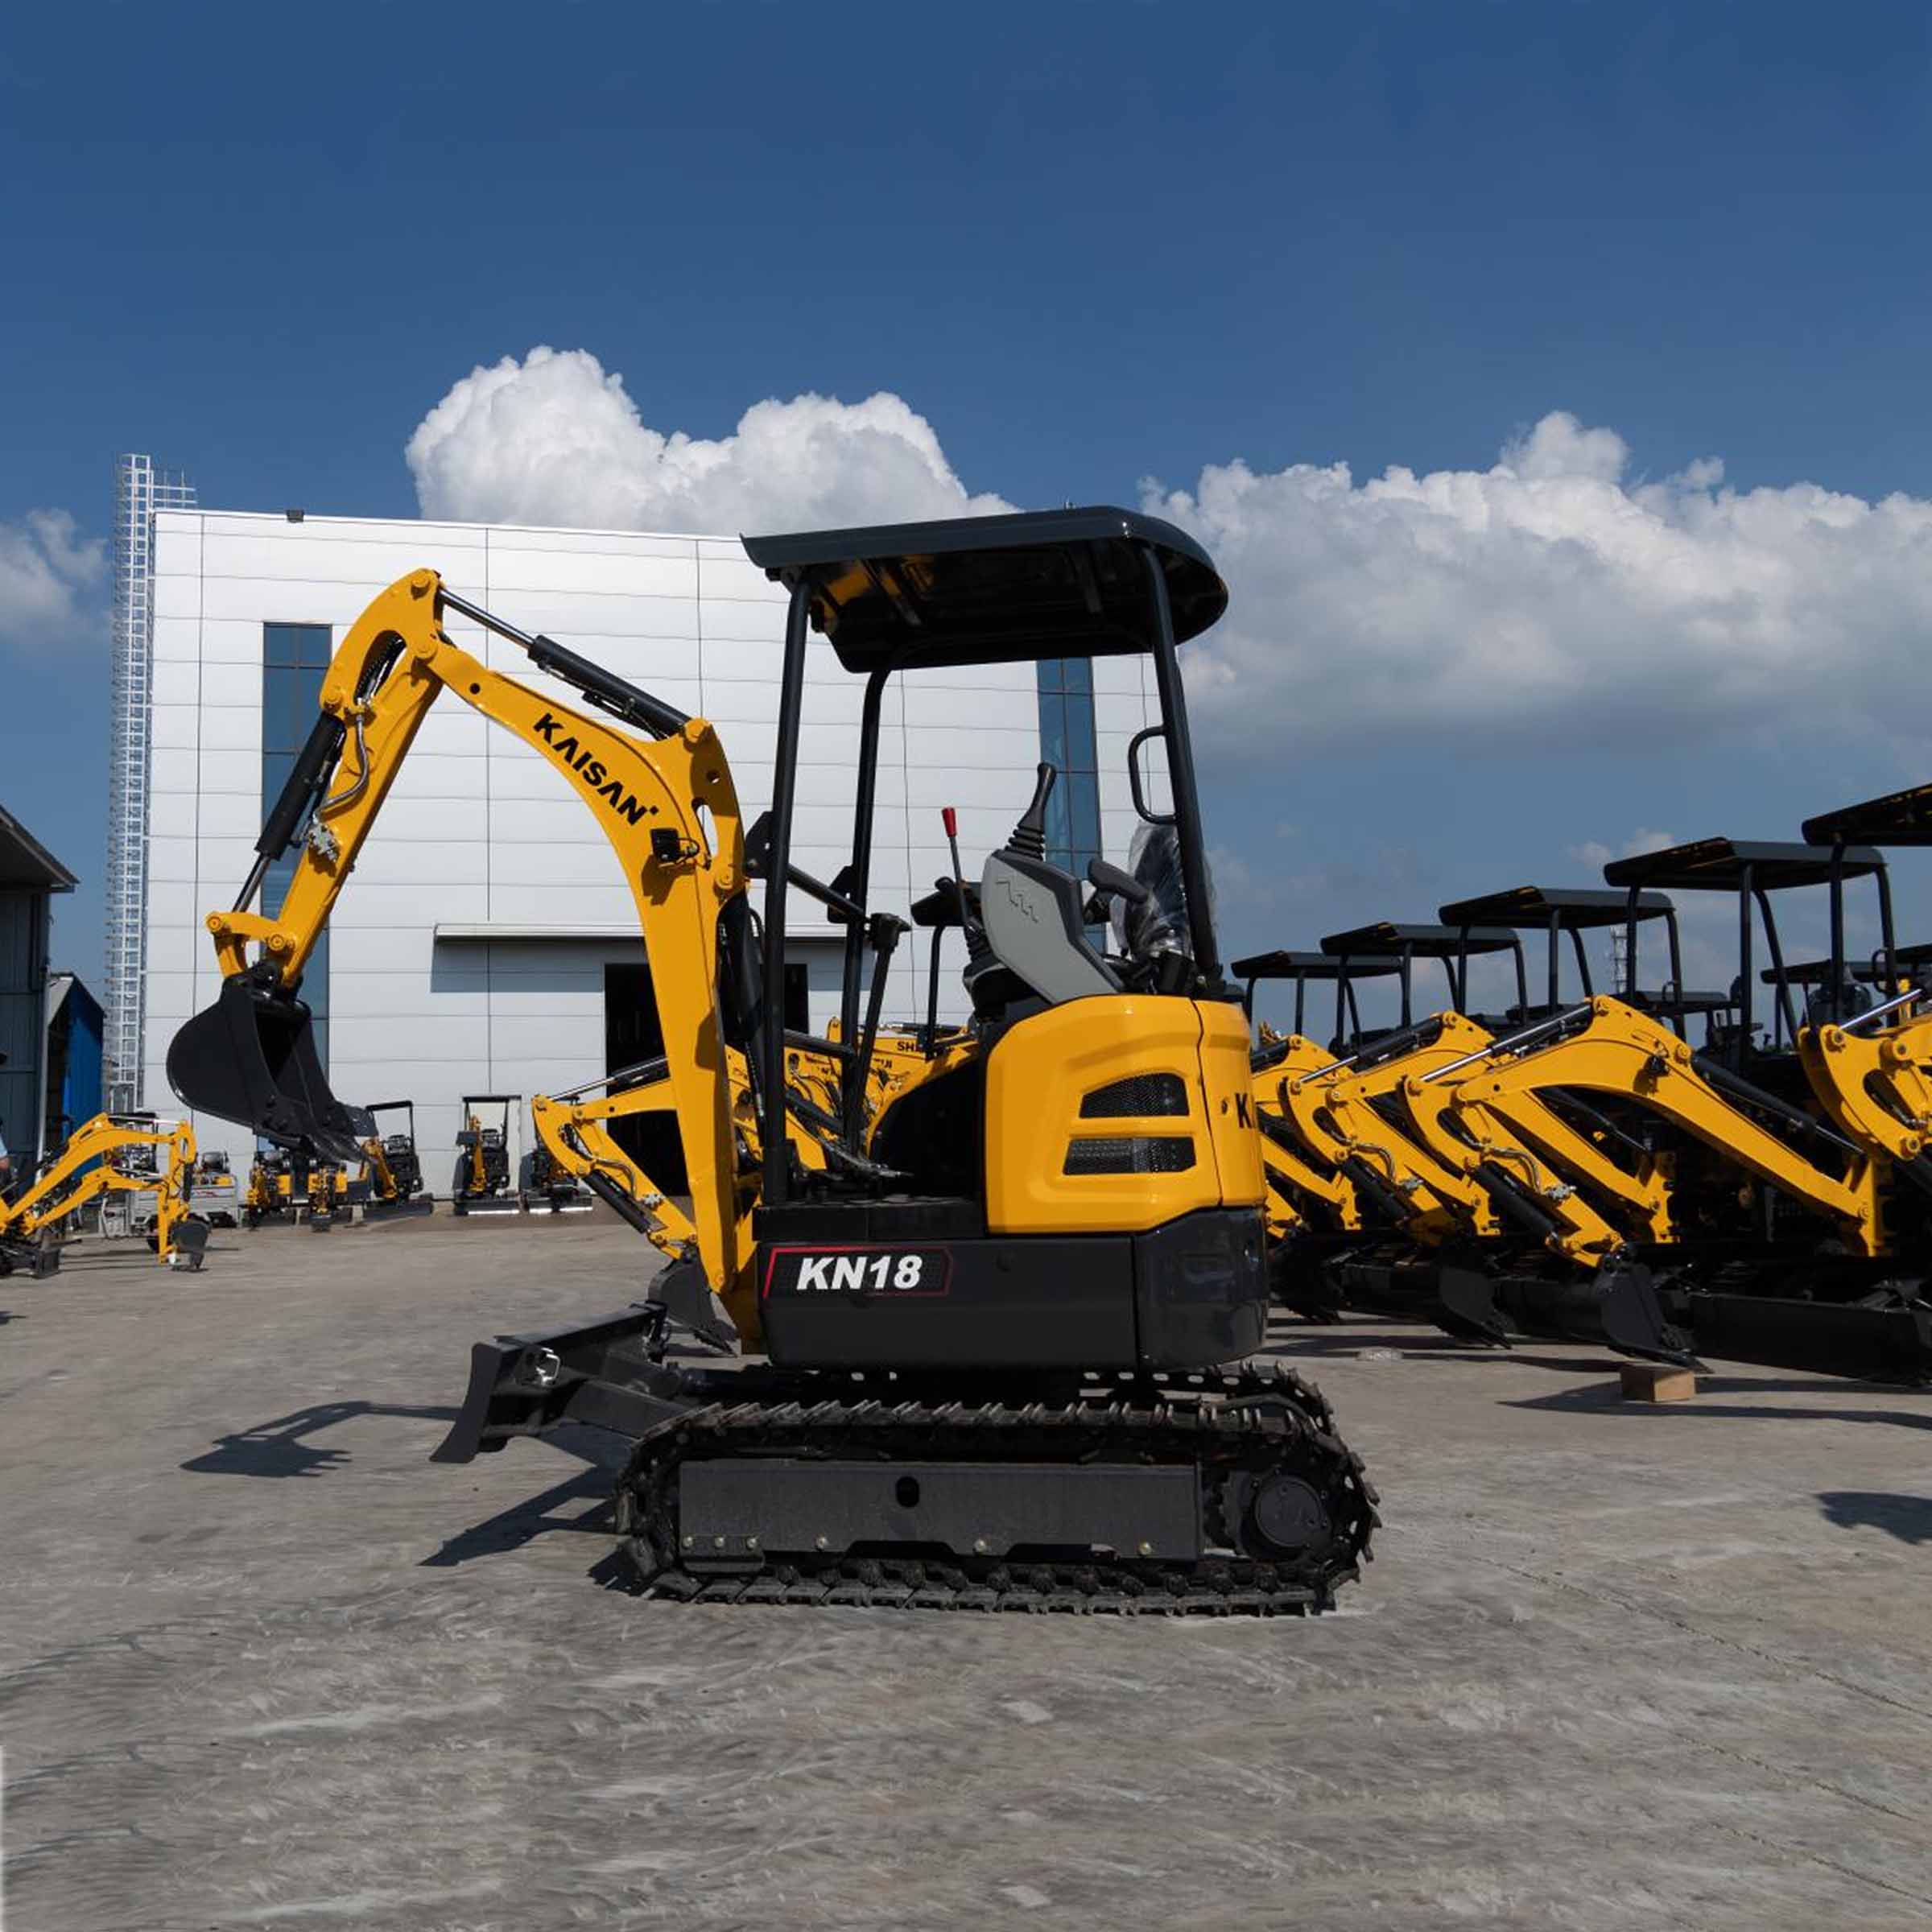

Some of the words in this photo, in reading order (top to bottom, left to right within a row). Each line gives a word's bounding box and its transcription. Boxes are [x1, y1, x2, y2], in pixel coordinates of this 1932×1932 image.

[533, 712, 649, 826] KAISAN
[1234, 1092, 1256, 1129] K
[796, 1255, 923, 1290] KN18
